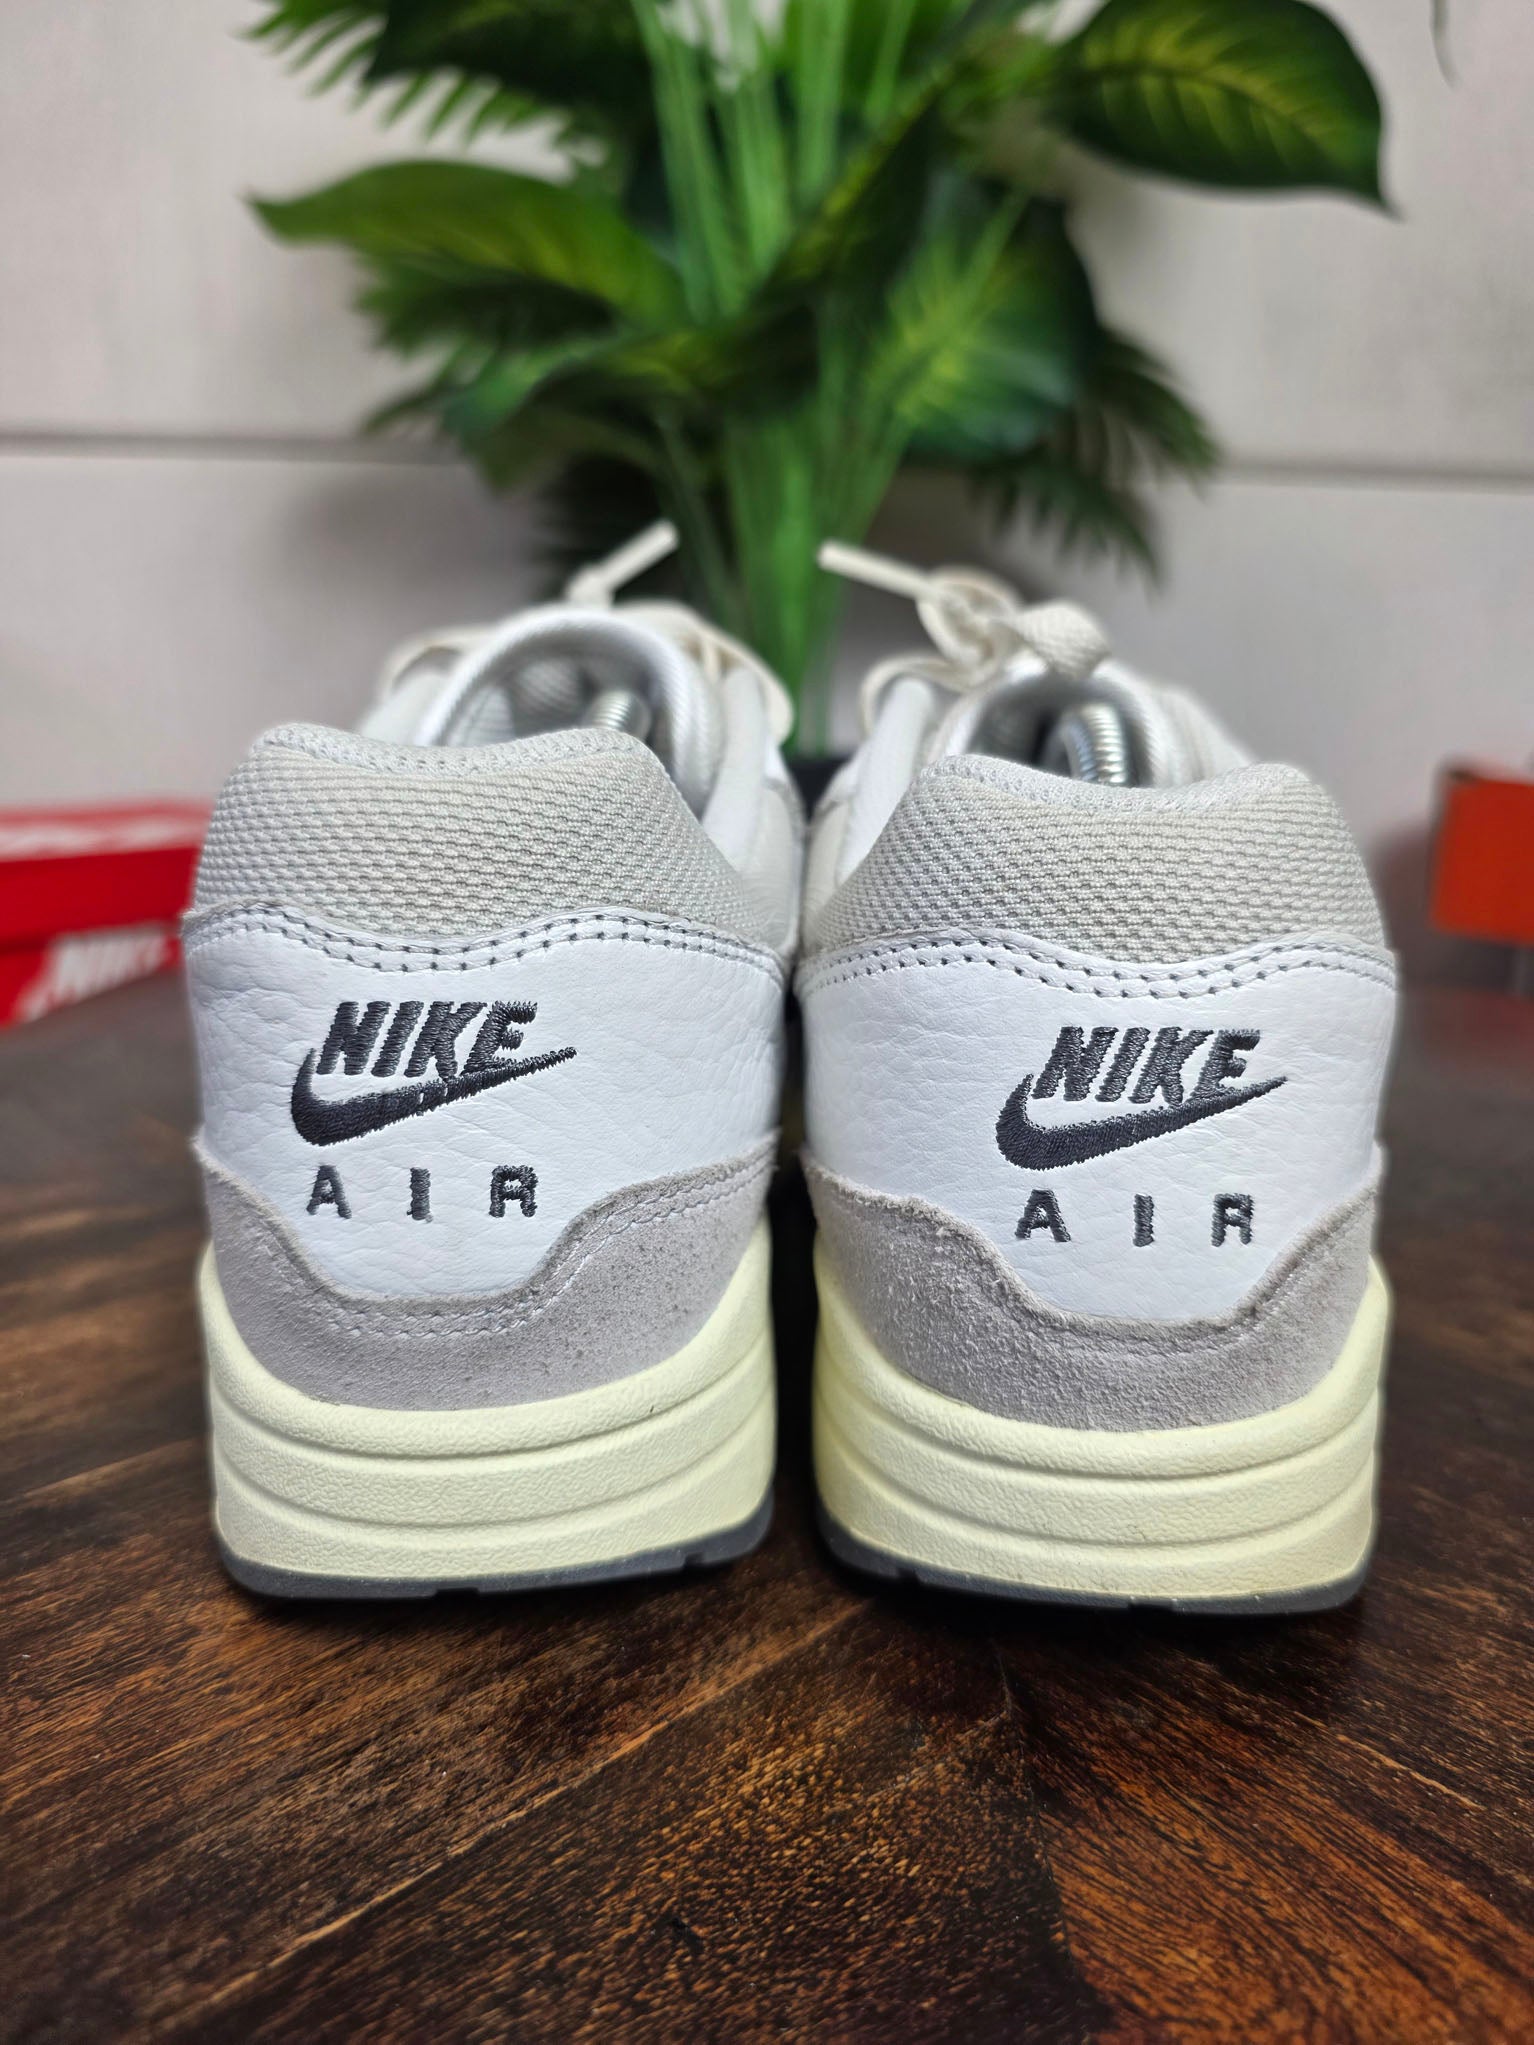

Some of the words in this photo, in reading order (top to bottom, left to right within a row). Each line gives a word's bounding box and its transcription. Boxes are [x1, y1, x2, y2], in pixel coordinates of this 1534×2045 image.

[316, 1000, 538, 1080] NIKE
[1031, 1026, 1261, 1106] NIKE
[306, 1165, 539, 1222] AIR
[1015, 1189, 1255, 1247] AIR
